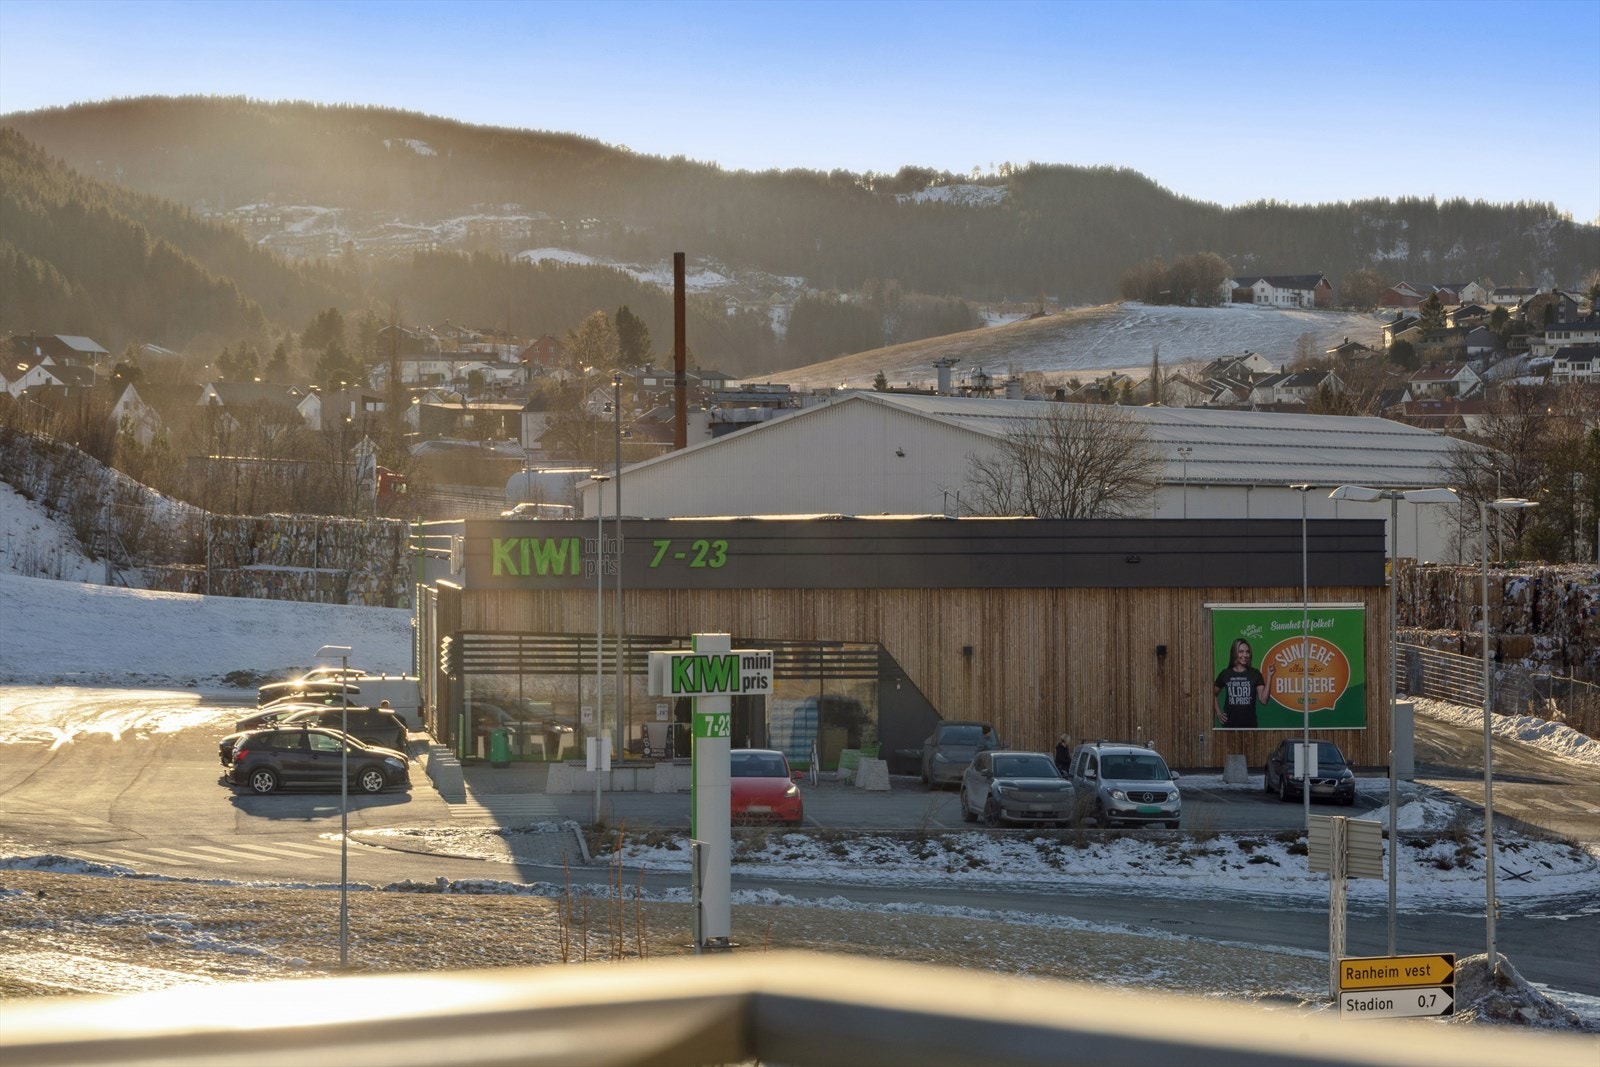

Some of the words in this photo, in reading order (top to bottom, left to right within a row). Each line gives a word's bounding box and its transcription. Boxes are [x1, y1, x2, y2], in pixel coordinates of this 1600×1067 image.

[585, 533, 625, 554] mini
[649, 540, 671, 568] 7
[689, 539, 729, 568] 23
[491, 538, 580, 576] KIWI
[585, 555, 621, 579] pris
[1302, 619, 1310, 629] tl
[742, 652, 771, 670] mini
[671, 654, 740, 694] KIWI
[742, 672, 768, 693] pris
[1275, 677, 1336, 694] BILLIGERE
[1346, 965, 1399, 980] Ranheim
[1404, 964, 1431, 977] vest
[1346, 997, 1394, 1012] Stadion
[1417, 994, 1437, 1009] 0,7
